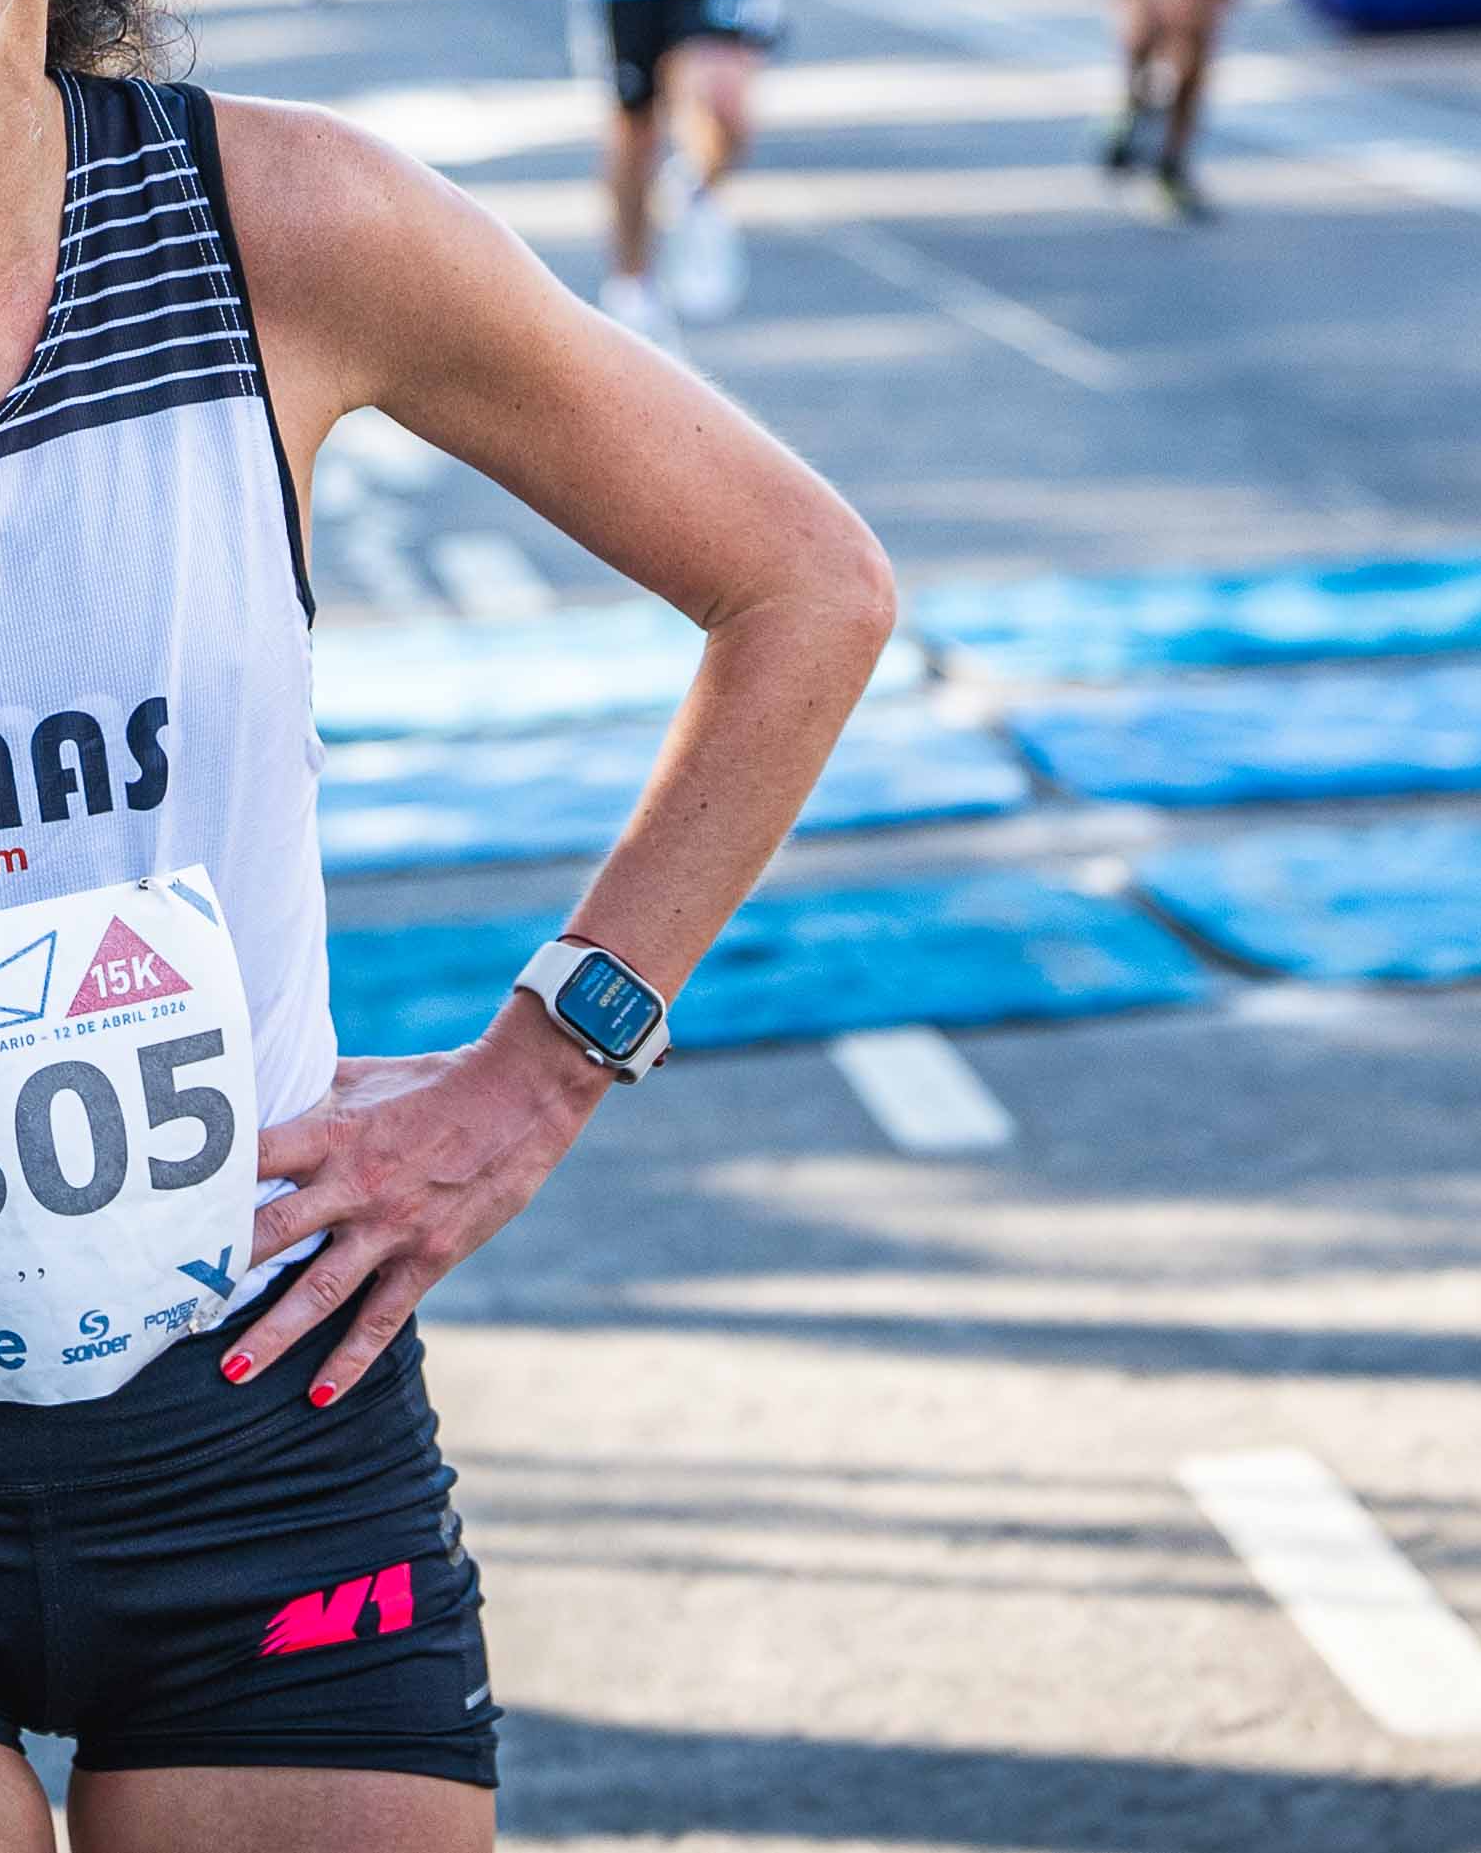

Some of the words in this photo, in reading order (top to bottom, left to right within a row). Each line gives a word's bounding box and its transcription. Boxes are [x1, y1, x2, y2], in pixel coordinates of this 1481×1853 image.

[88, 956, 160, 998] 15K
[53, 1025, 71, 1040] 12
[77, 1020, 96, 1035] DE
[102, 1011, 146, 1030] ABRIL
[152, 1000, 186, 1020] 2026
[144, 1297, 198, 1329] POWER
